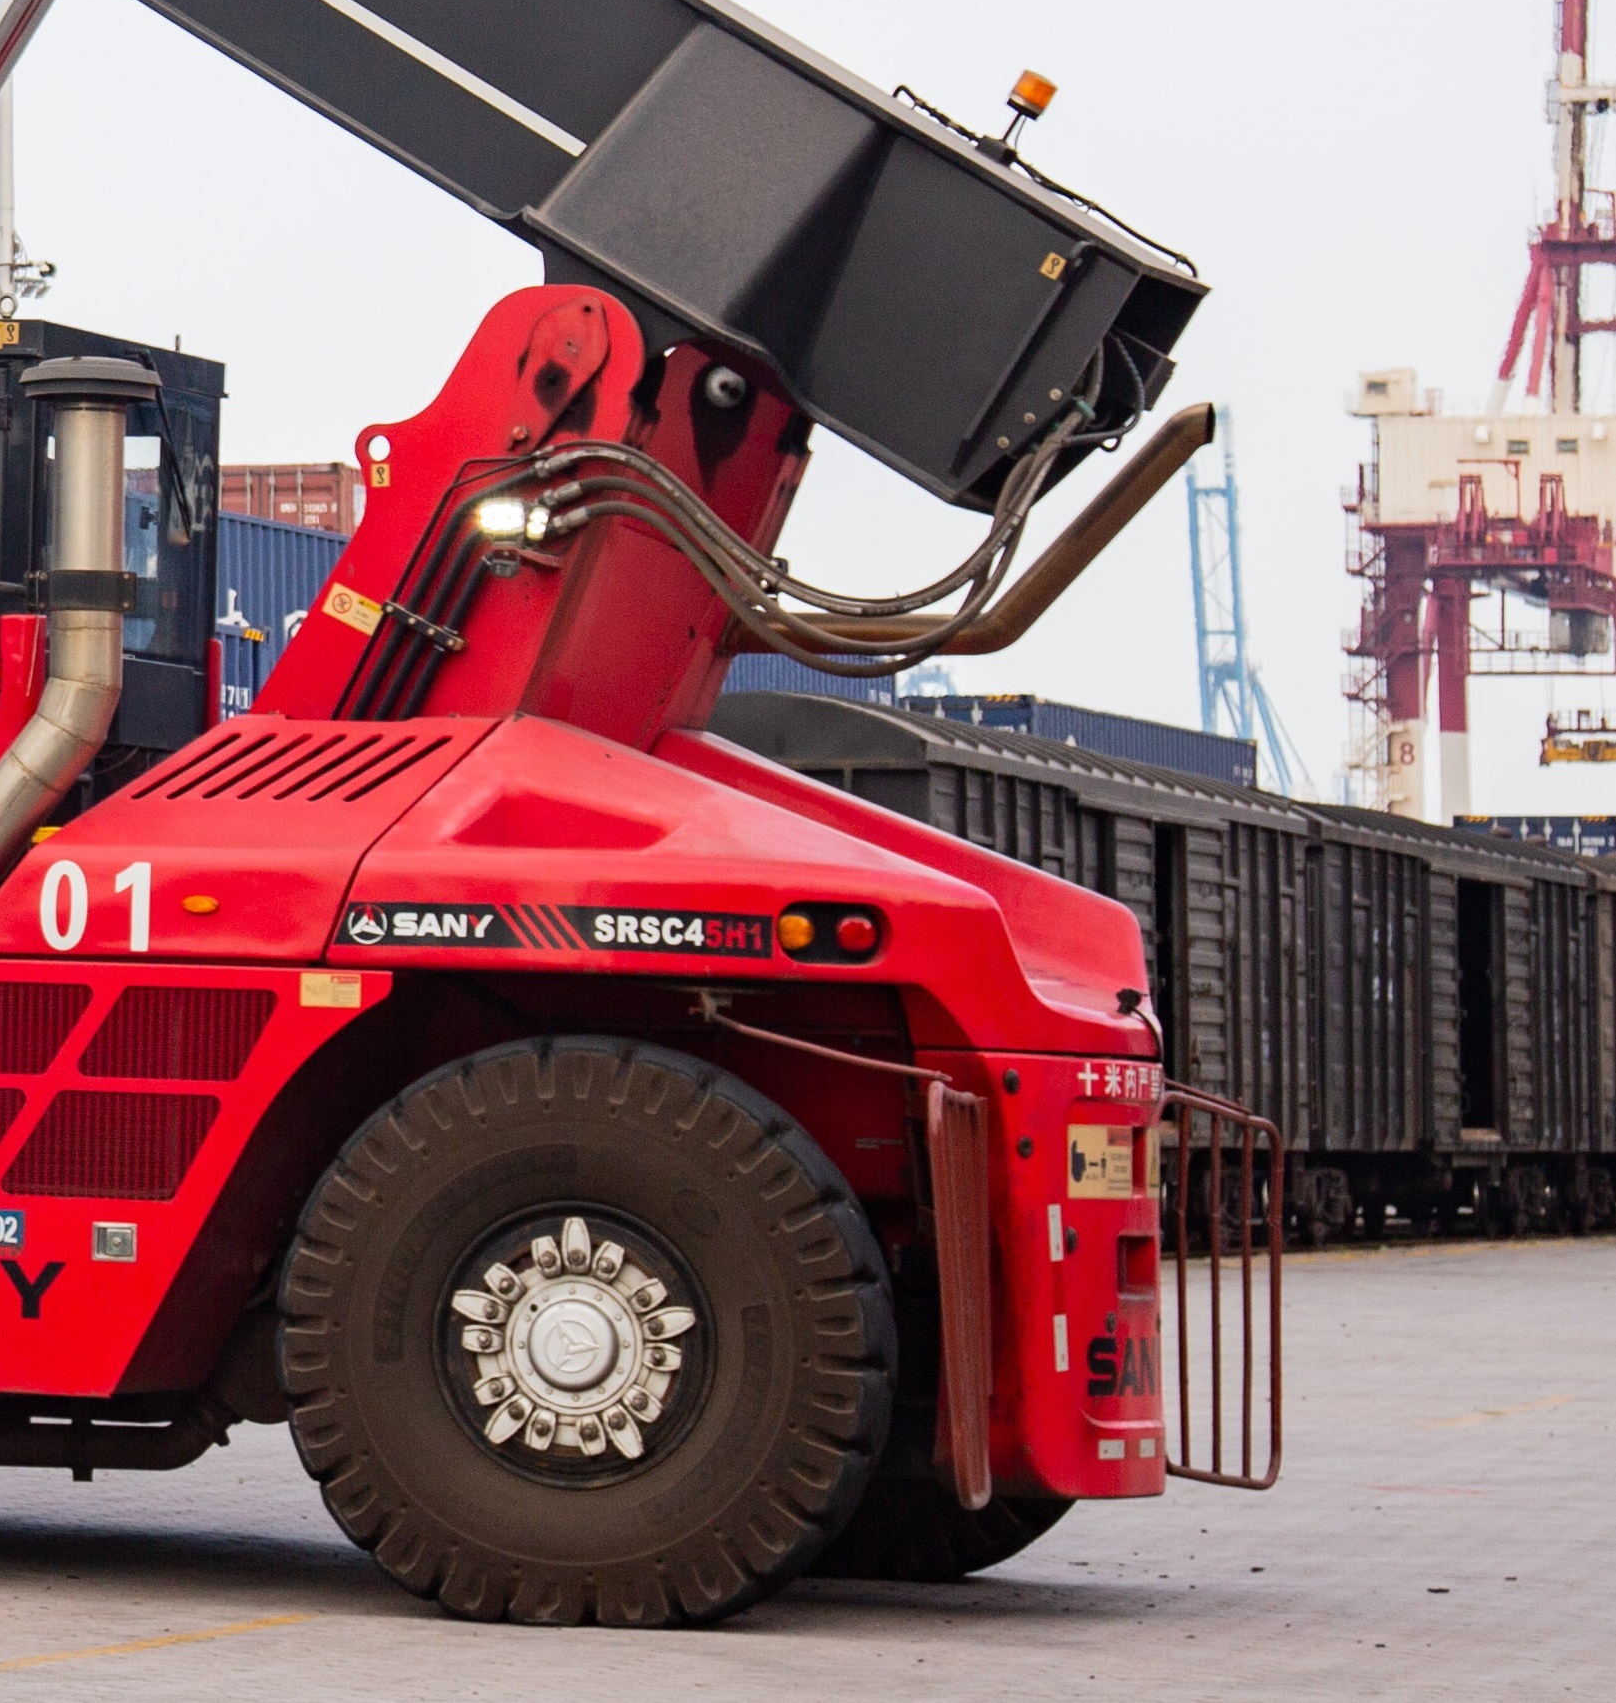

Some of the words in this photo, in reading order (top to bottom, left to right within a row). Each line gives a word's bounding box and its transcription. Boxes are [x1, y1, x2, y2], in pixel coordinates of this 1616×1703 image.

[1400, 741, 1415, 766] 8
[39, 860, 152, 952] 01
[393, 912, 494, 938] SANY
[594, 914, 764, 950] SRSC45H1
